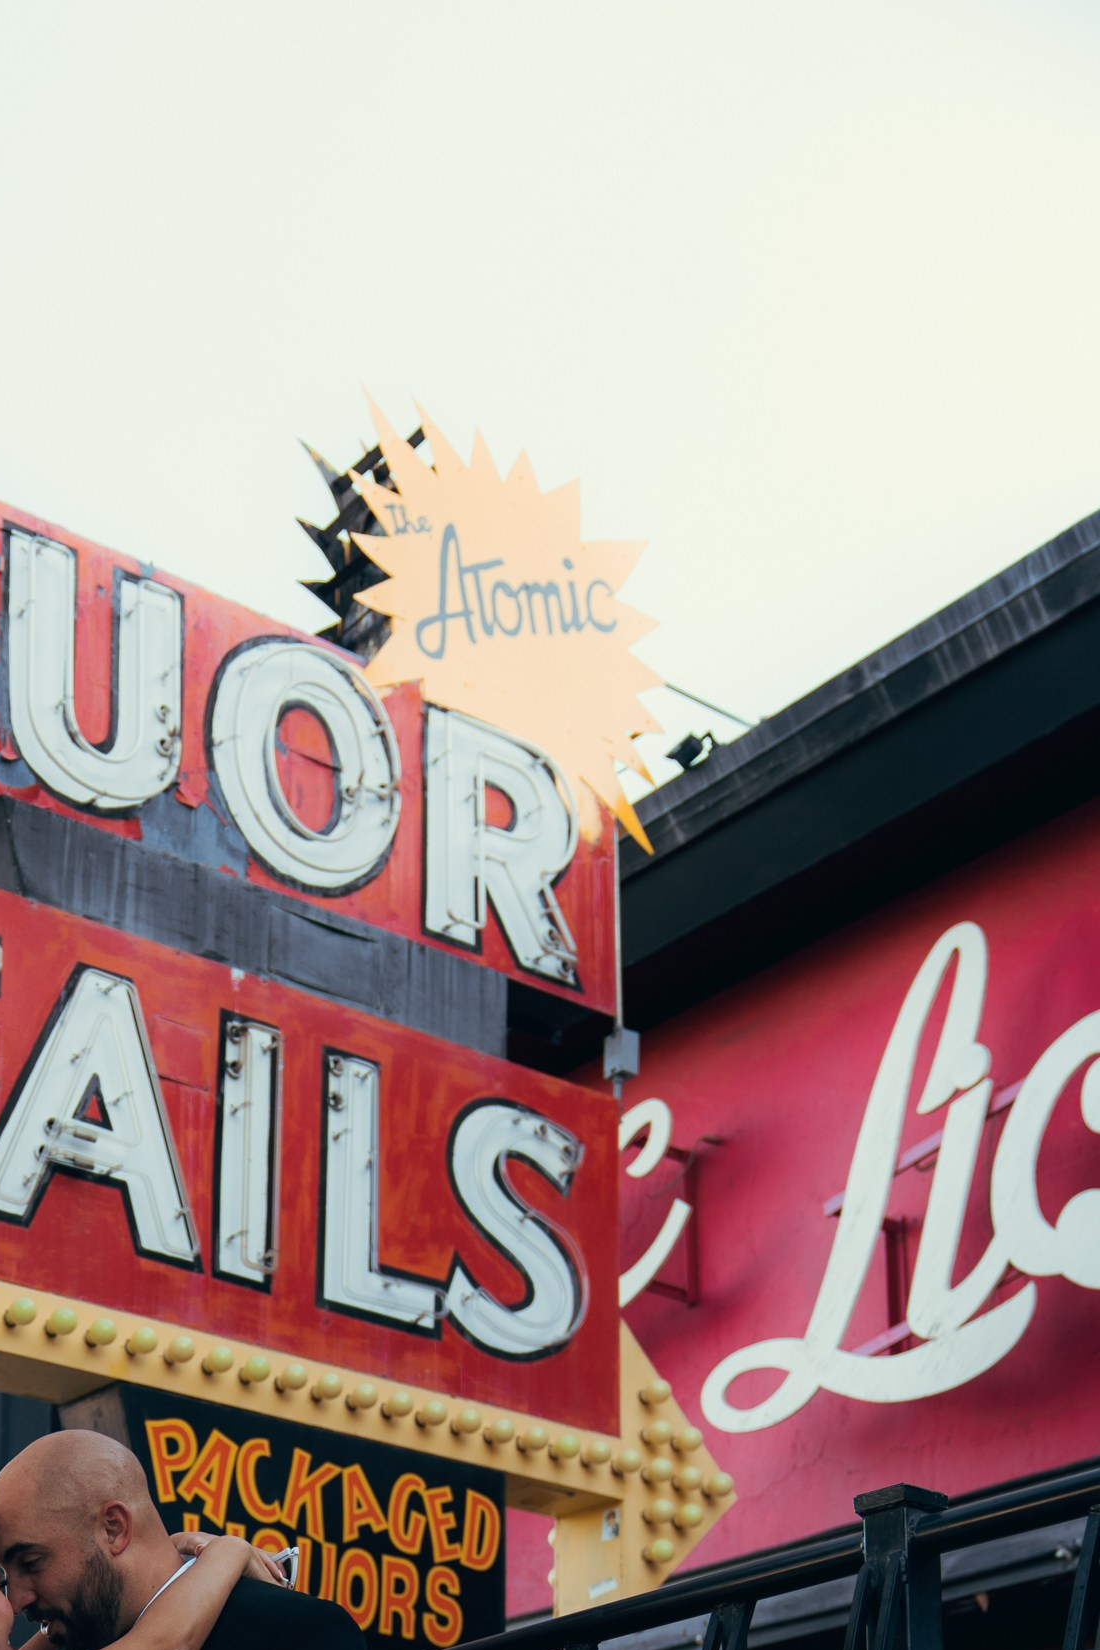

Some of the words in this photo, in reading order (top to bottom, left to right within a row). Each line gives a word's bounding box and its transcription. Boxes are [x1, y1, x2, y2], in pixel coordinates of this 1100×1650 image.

[416, 523, 616, 659] Atomic
[145, 1417, 500, 1571] PACKAGED
[183, 1513, 463, 1648] UORS
